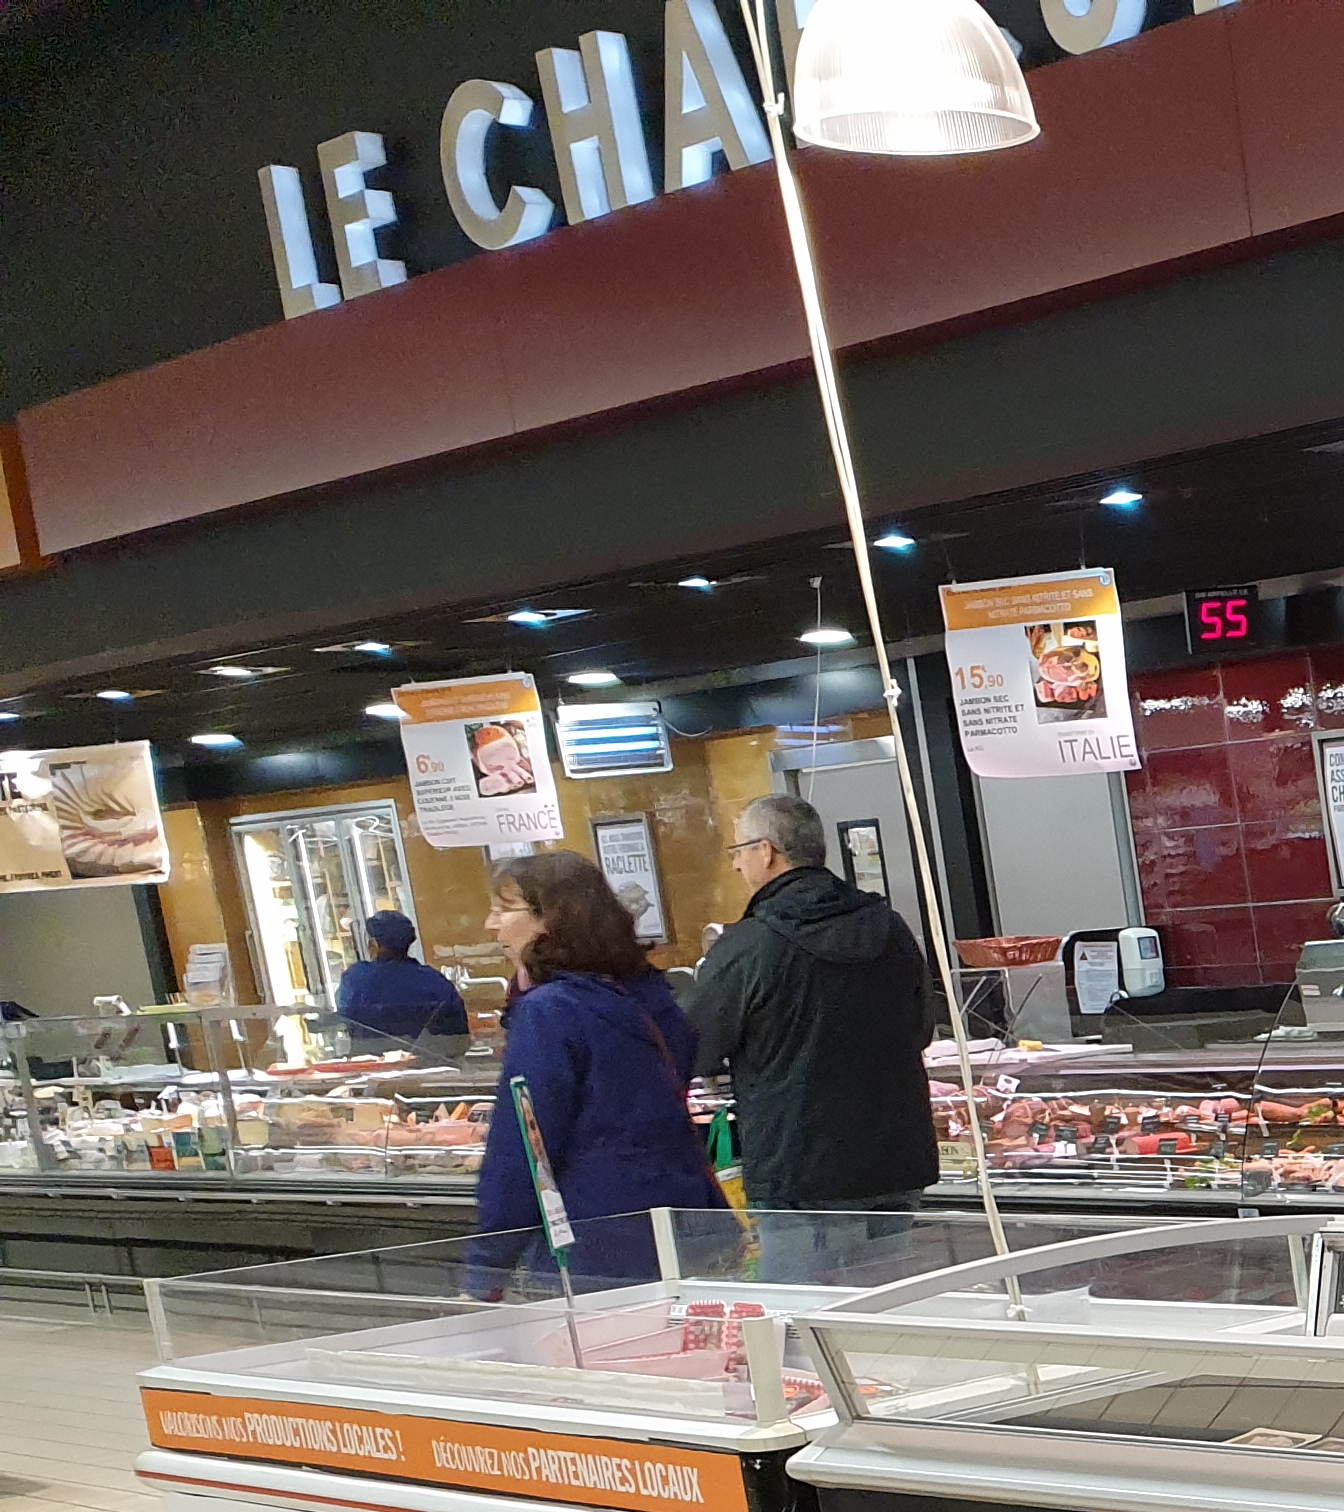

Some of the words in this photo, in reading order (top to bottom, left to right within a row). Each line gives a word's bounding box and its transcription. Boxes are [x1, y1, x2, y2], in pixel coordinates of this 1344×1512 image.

[259, 130, 407, 321] LE
[1200, 598, 1248, 640] 55
[1057, 734, 1135, 764] ITALIE
[496, 809, 558, 834] FRANCE
[605, 854, 649, 874] RACLETTE
[159, 1410, 222, 1440] VALORISONS
[223, 1416, 248, 1442] NOS
[244, 1412, 338, 1451] PRODUCTIONS
[335, 1422, 398, 1461] LOCALES
[431, 1436, 502, 1475] DÉCOUVREZ
[502, 1450, 530, 1480] NOS
[527, 1447, 636, 1494] PARTENAIRES
[635, 1459, 705, 1504] LOCAUX
